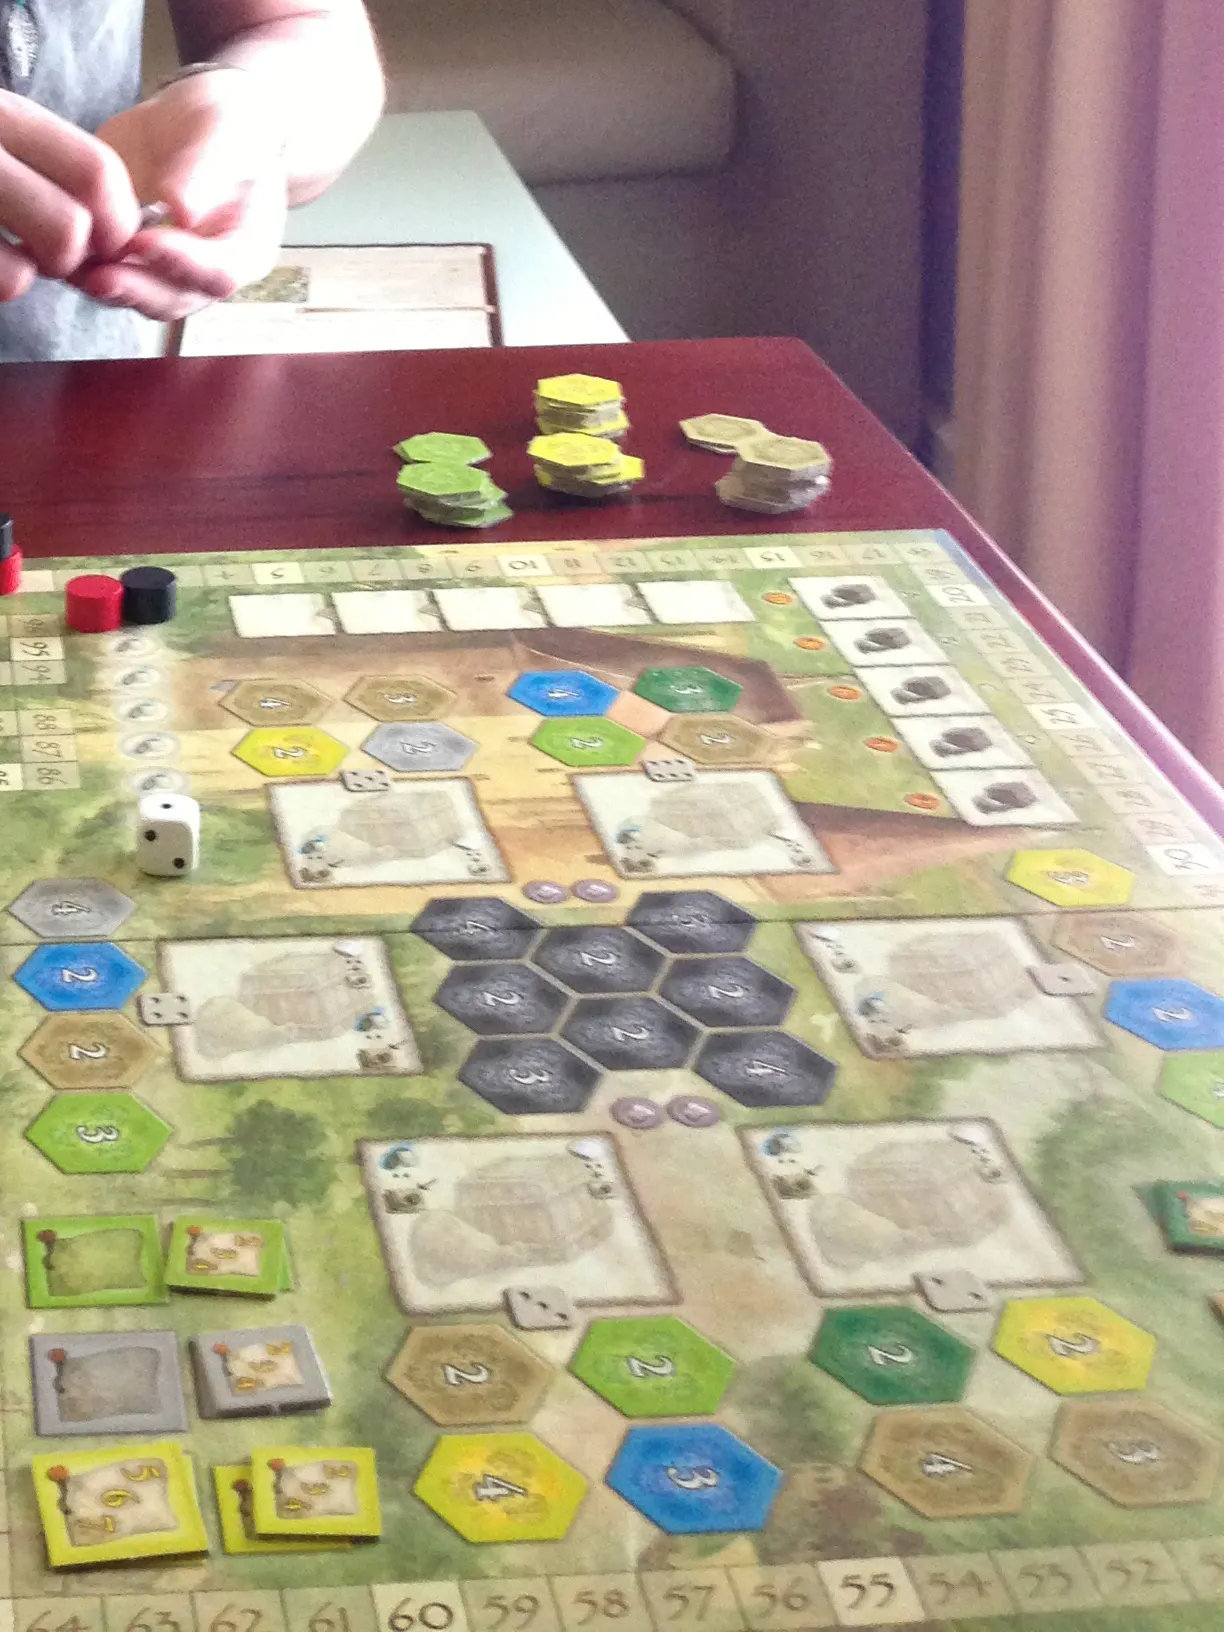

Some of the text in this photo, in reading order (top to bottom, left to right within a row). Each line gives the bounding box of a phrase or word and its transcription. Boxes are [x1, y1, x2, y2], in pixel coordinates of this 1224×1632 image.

[19, 641, 51, 657] 95
[21, 665, 52, 681] 94
[33, 713, 57, 731] 88
[401, 740, 435, 754] 2
[570, 735, 604, 749] 2
[700, 732, 733, 746] 2
[32, 740, 63, 758] 87
[270, 745, 305, 759] 2
[37, 767, 68, 785] 86
[52, 901, 90, 917] 4
[580, 951, 621, 967] 2
[61, 967, 98, 984] 2
[483, 990, 524, 1007] 2
[708, 982, 749, 1000] 2
[610, 1023, 652, 1042] 2
[69, 1042, 109, 1060] 2
[508, 1067, 553, 1086] 3
[76, 1125, 120, 1144] 3
[866, 1341, 917, 1367] 2
[1046, 1332, 1101, 1357] 2
[443, 1361, 492, 1386] 2
[626, 1354, 674, 1379] 2
[666, 1464, 719, 1490] 3
[475, 1473, 527, 1501] 4
[101, 1487, 140, 1509] 6
[752, 1575, 812, 1619] 56
[841, 1572, 894, 1610] 55
[929, 1569, 991, 1606] 54
[574, 1588, 630, 1626] 58
[663, 1584, 716, 1621] 57
[308, 1601, 352, 1632] 61
[388, 1597, 454, 1632] 60
[483, 1594, 540, 1632] 59
